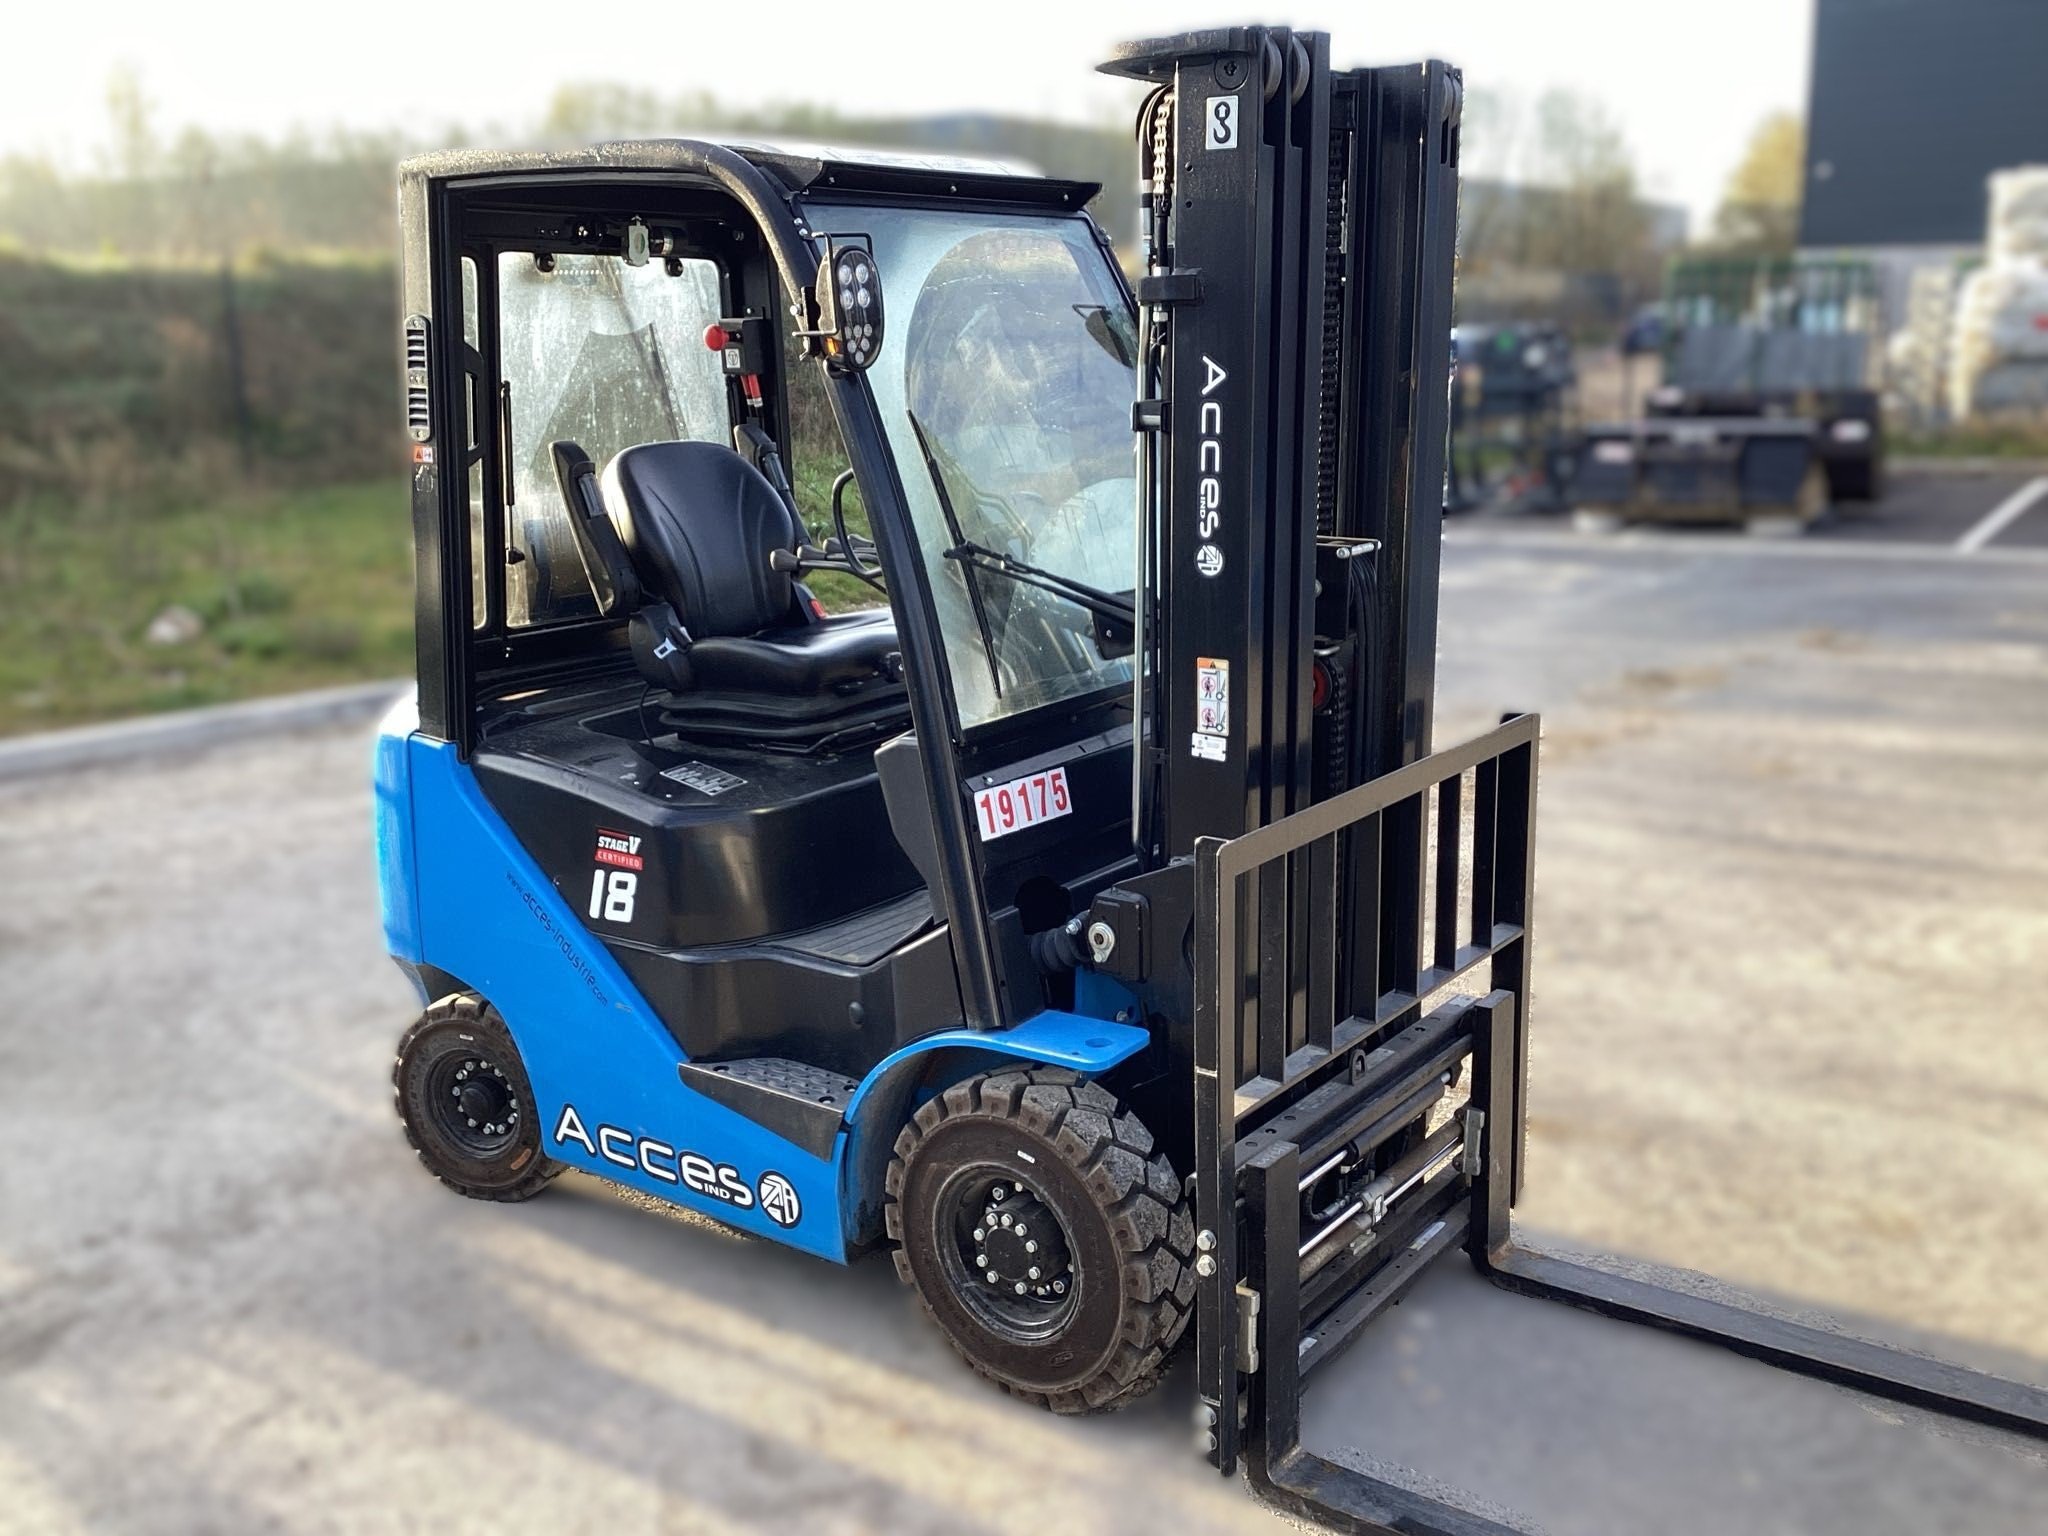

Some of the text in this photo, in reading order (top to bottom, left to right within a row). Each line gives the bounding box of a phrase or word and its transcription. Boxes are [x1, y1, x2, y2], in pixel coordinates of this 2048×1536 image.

[980, 773, 1068, 834] 19175
[598, 836, 641, 855] STAGE V
[597, 851, 641, 868] CERTIFIED
[589, 869, 637, 923] 18
[704, 1183, 731, 1199] IND
